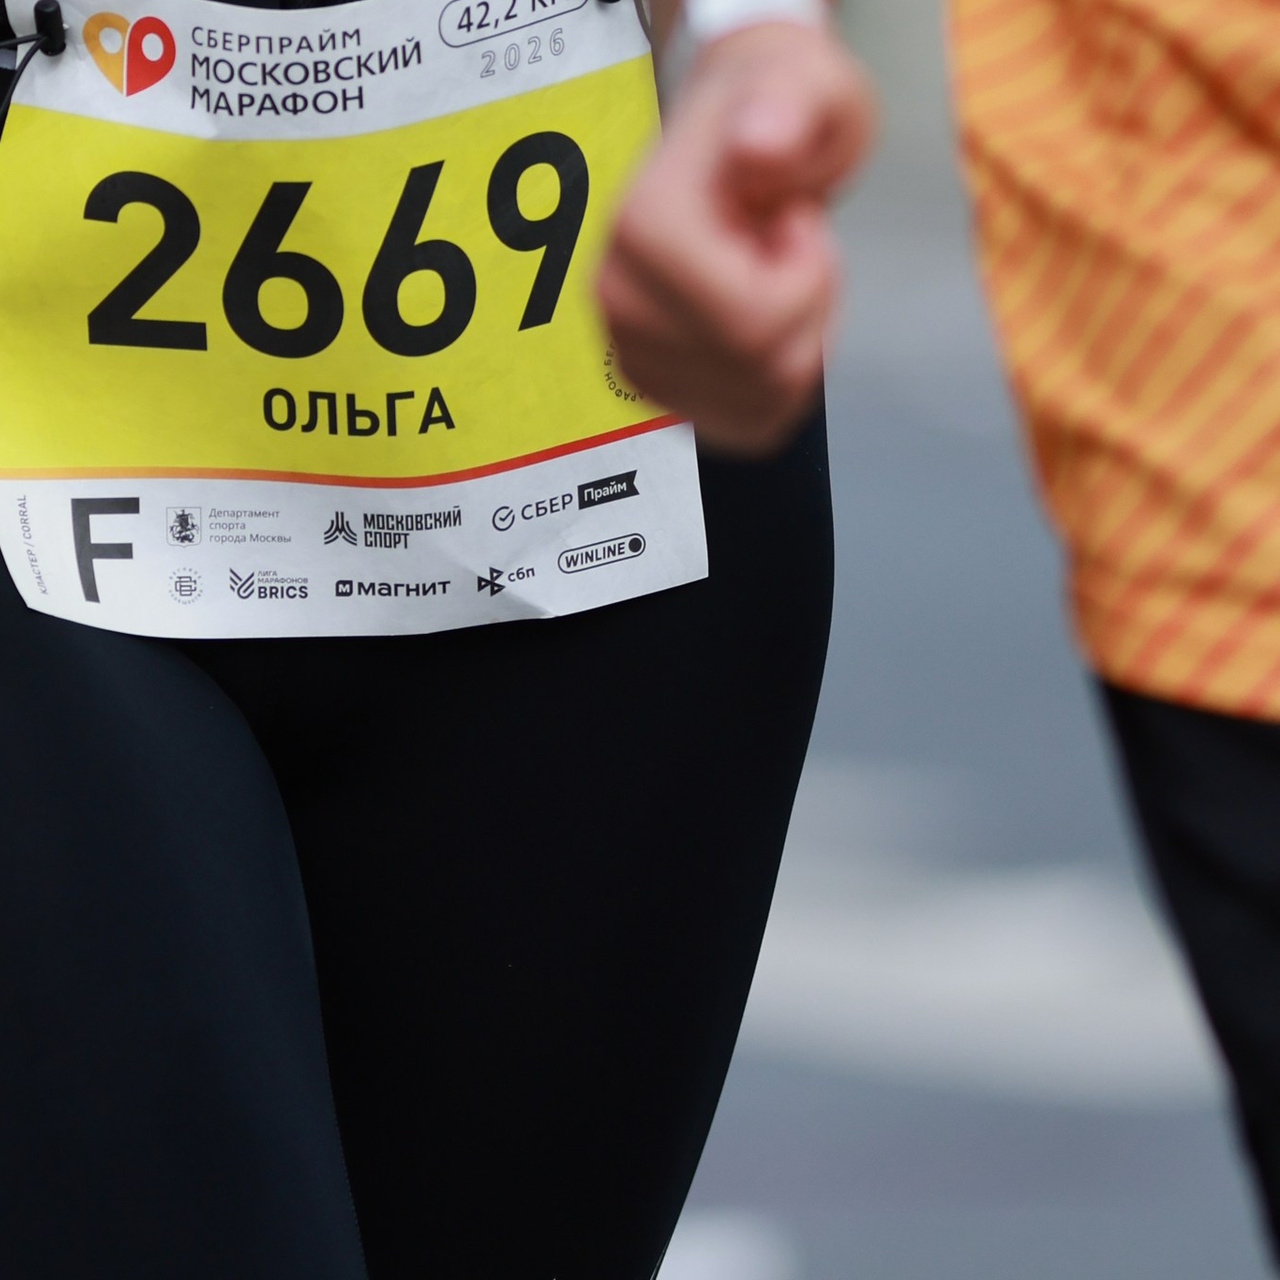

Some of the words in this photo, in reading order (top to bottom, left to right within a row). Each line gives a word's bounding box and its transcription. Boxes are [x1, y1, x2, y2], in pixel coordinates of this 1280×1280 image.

[191, 26, 361, 54] СБЕРПРАЙМ
[479, 27, 565, 79] 2026
[191, 36, 423, 86] МОСКОВСКИЙ
[190, 86, 365, 116] МАРАФОН
[82, 130, 591, 360] 2669
[262, 386, 456, 437] ОЛЬГА
[208, 508, 280, 519] Департамент
[520, 493, 574, 521] СБЕР
[583, 481, 628, 502] Прайм
[17, 495, 32, 540] CORRAL
[209, 521, 246, 531] спорта
[363, 505, 462, 531] МОСКОВСКИЙ
[70, 496, 140, 604] F
[209, 534, 247, 544] города
[250, 534, 292, 543] Москвы
[364, 531, 410, 549] СПОРТ
[564, 541, 626, 569] WINLINE
[25, 549, 49, 596] КЛАСТЕР
[507, 566, 536, 583] сбп
[257, 585, 309, 599] BRICS
[357, 580, 452, 597] магнит
